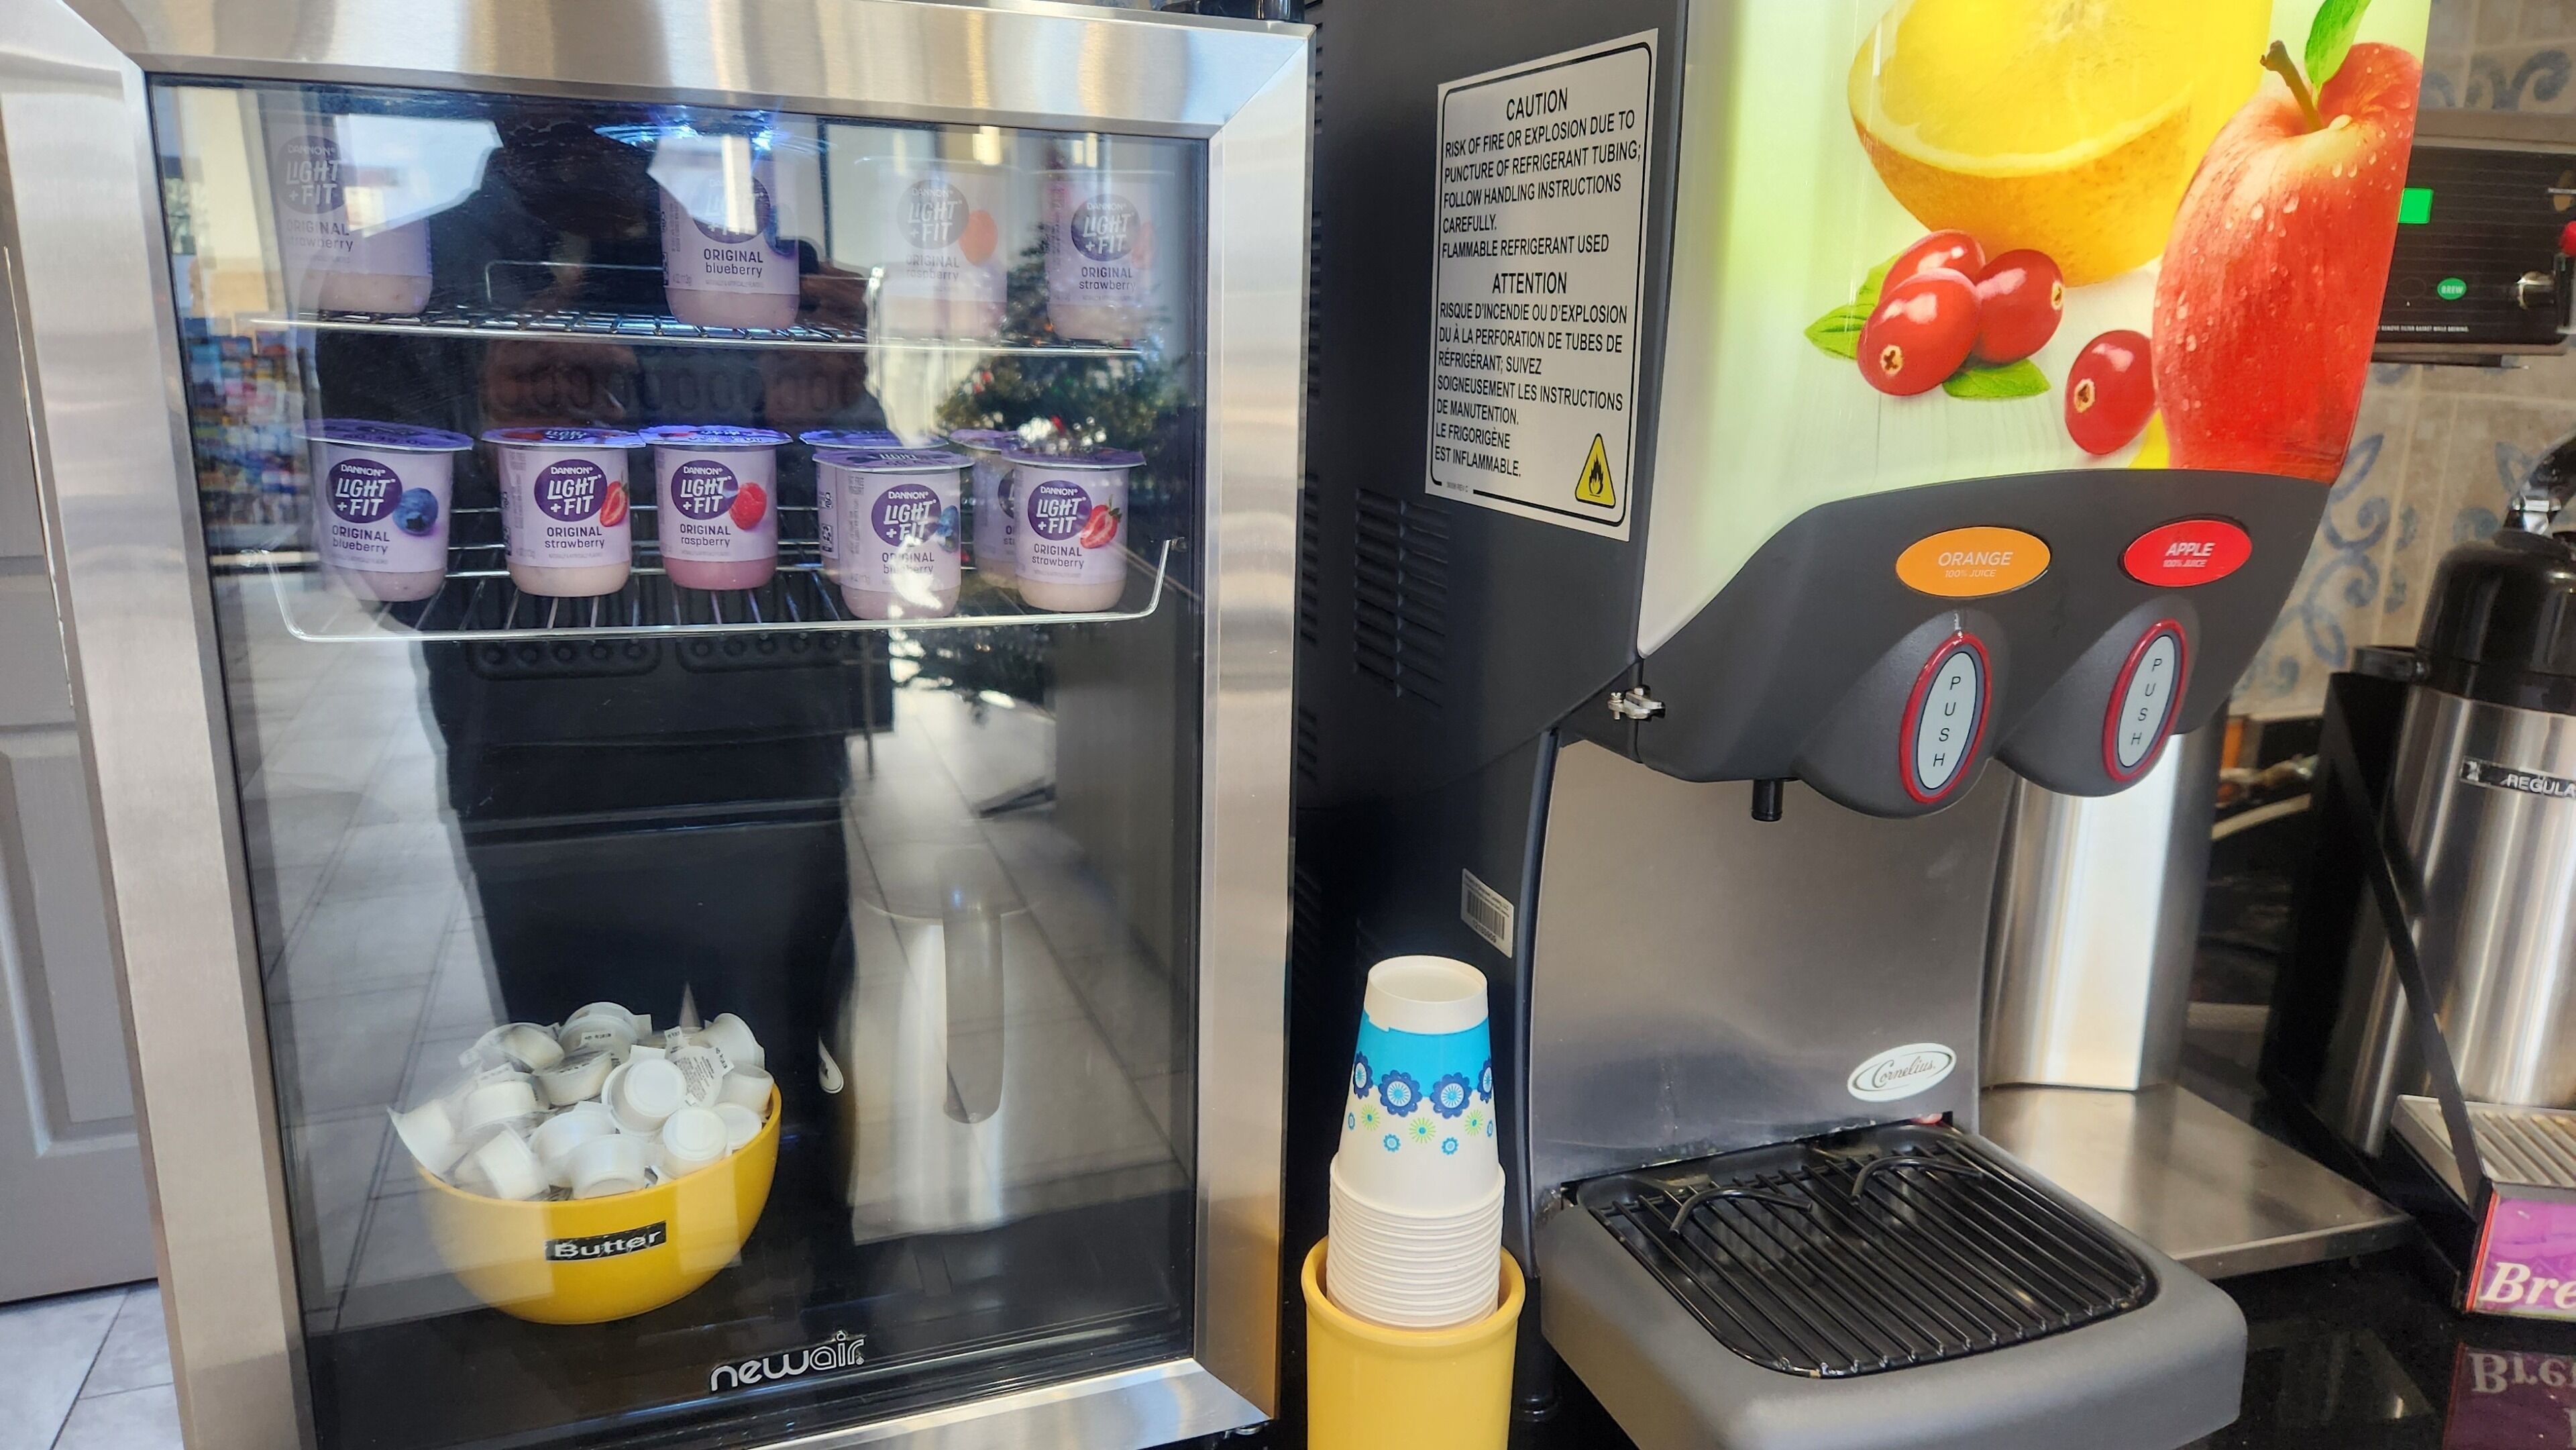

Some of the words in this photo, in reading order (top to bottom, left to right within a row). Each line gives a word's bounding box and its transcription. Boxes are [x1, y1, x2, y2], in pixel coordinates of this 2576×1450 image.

[1507, 87, 1568, 121] CAUTION
[1445, 139, 1466, 158] RISK
[1468, 137, 1481, 154] OF
[1483, 134, 1504, 152] FIRE
[1507, 131, 1521, 148] OR
[1525, 118, 1587, 144] EXPLOSION
[1591, 113, 1615, 135] DUE
[1619, 110, 1635, 130] TO
[1444, 161, 1494, 184] PUNCTURE
[1497, 160, 1509, 177] OF
[1513, 147, 1589, 175] REFRIGERANT
[1593, 140, 1641, 162] TUBING;
[1444, 190, 1482, 209] FOLLOW
[1484, 183, 1535, 205] HANDLING
[1538, 173, 1621, 199] INSTRUCTIONS
[1443, 214, 1497, 234] CAREFULLY.
[287, 236, 354, 252] trawberry
[1442, 240, 1498, 258] FLAMMABLE
[1501, 236, 1575, 256] REFRIGERANT
[1577, 234, 1609, 254] USED
[704, 248, 763, 263] ORIGINAL
[906, 254, 960, 268] ORIGINAL
[706, 262, 762, 278] blueberry
[1081, 266, 1133, 278] ORIGINAL
[1079, 280, 1136, 291] strawberry
[1492, 272, 1567, 294] ATTENTION
[2441, 285, 2463, 294] BREW
[1440, 303, 1472, 319] RISQUE
[1475, 303, 1529, 321] D'INCENDIE
[1532, 305, 1547, 321] OU
[1550, 305, 1627, 323] D'EXPLOSION
[1439, 326, 1451, 342] DU
[1453, 323, 1460, 343] À
[1462, 328, 1473, 344] LA
[1475, 329, 1544, 348] PERFORATION
[1548, 332, 1562, 349] DE
[1565, 333, 1603, 352] TUBES
[1606, 335, 1623, 353] DE
[1438, 348, 1503, 374] RÉFRIGÉRANT;
[1506, 357, 1542, 375] SUIVEZ
[1438, 375, 1515, 399] SOIGNEUSEMENT
[1518, 383, 1537, 401] LES
[1540, 385, 1623, 411] INSTRUCTIONS
[1437, 399, 1448, 415] DE
[1450, 401, 1519, 425] MANUTENTION.
[1436, 422, 1446, 438] LE
[1448, 424, 1510, 450] FRIGORIGÈNE
[1435, 446, 1450, 462] EST
[1452, 450, 1521, 477] INFLAMMABLE.
[332, 525, 390, 541] ORIGINAL
[547, 527, 602, 537] ORIGINAL
[680, 523, 731, 535] ORIGINAL
[333, 538, 388, 555] blueberry
[545, 538, 604, 549] strawberry
[681, 536, 731, 548] raspberry
[1034, 543, 1082, 556] ORIGINAL
[2165, 542, 2216, 556] APPLE
[1032, 556, 1084, 569] strawberry
[1938, 552, 2013, 566] ORANGE
[2183, 559, 2208, 568] JUICE
[1945, 570, 1968, 578] 100%
[1969, 569, 1996, 578] JUICE
[2130, 658, 2163, 745] PUSH
[1932, 676, 1962, 768] PUSH
[555, 1231, 661, 1257] Butter
